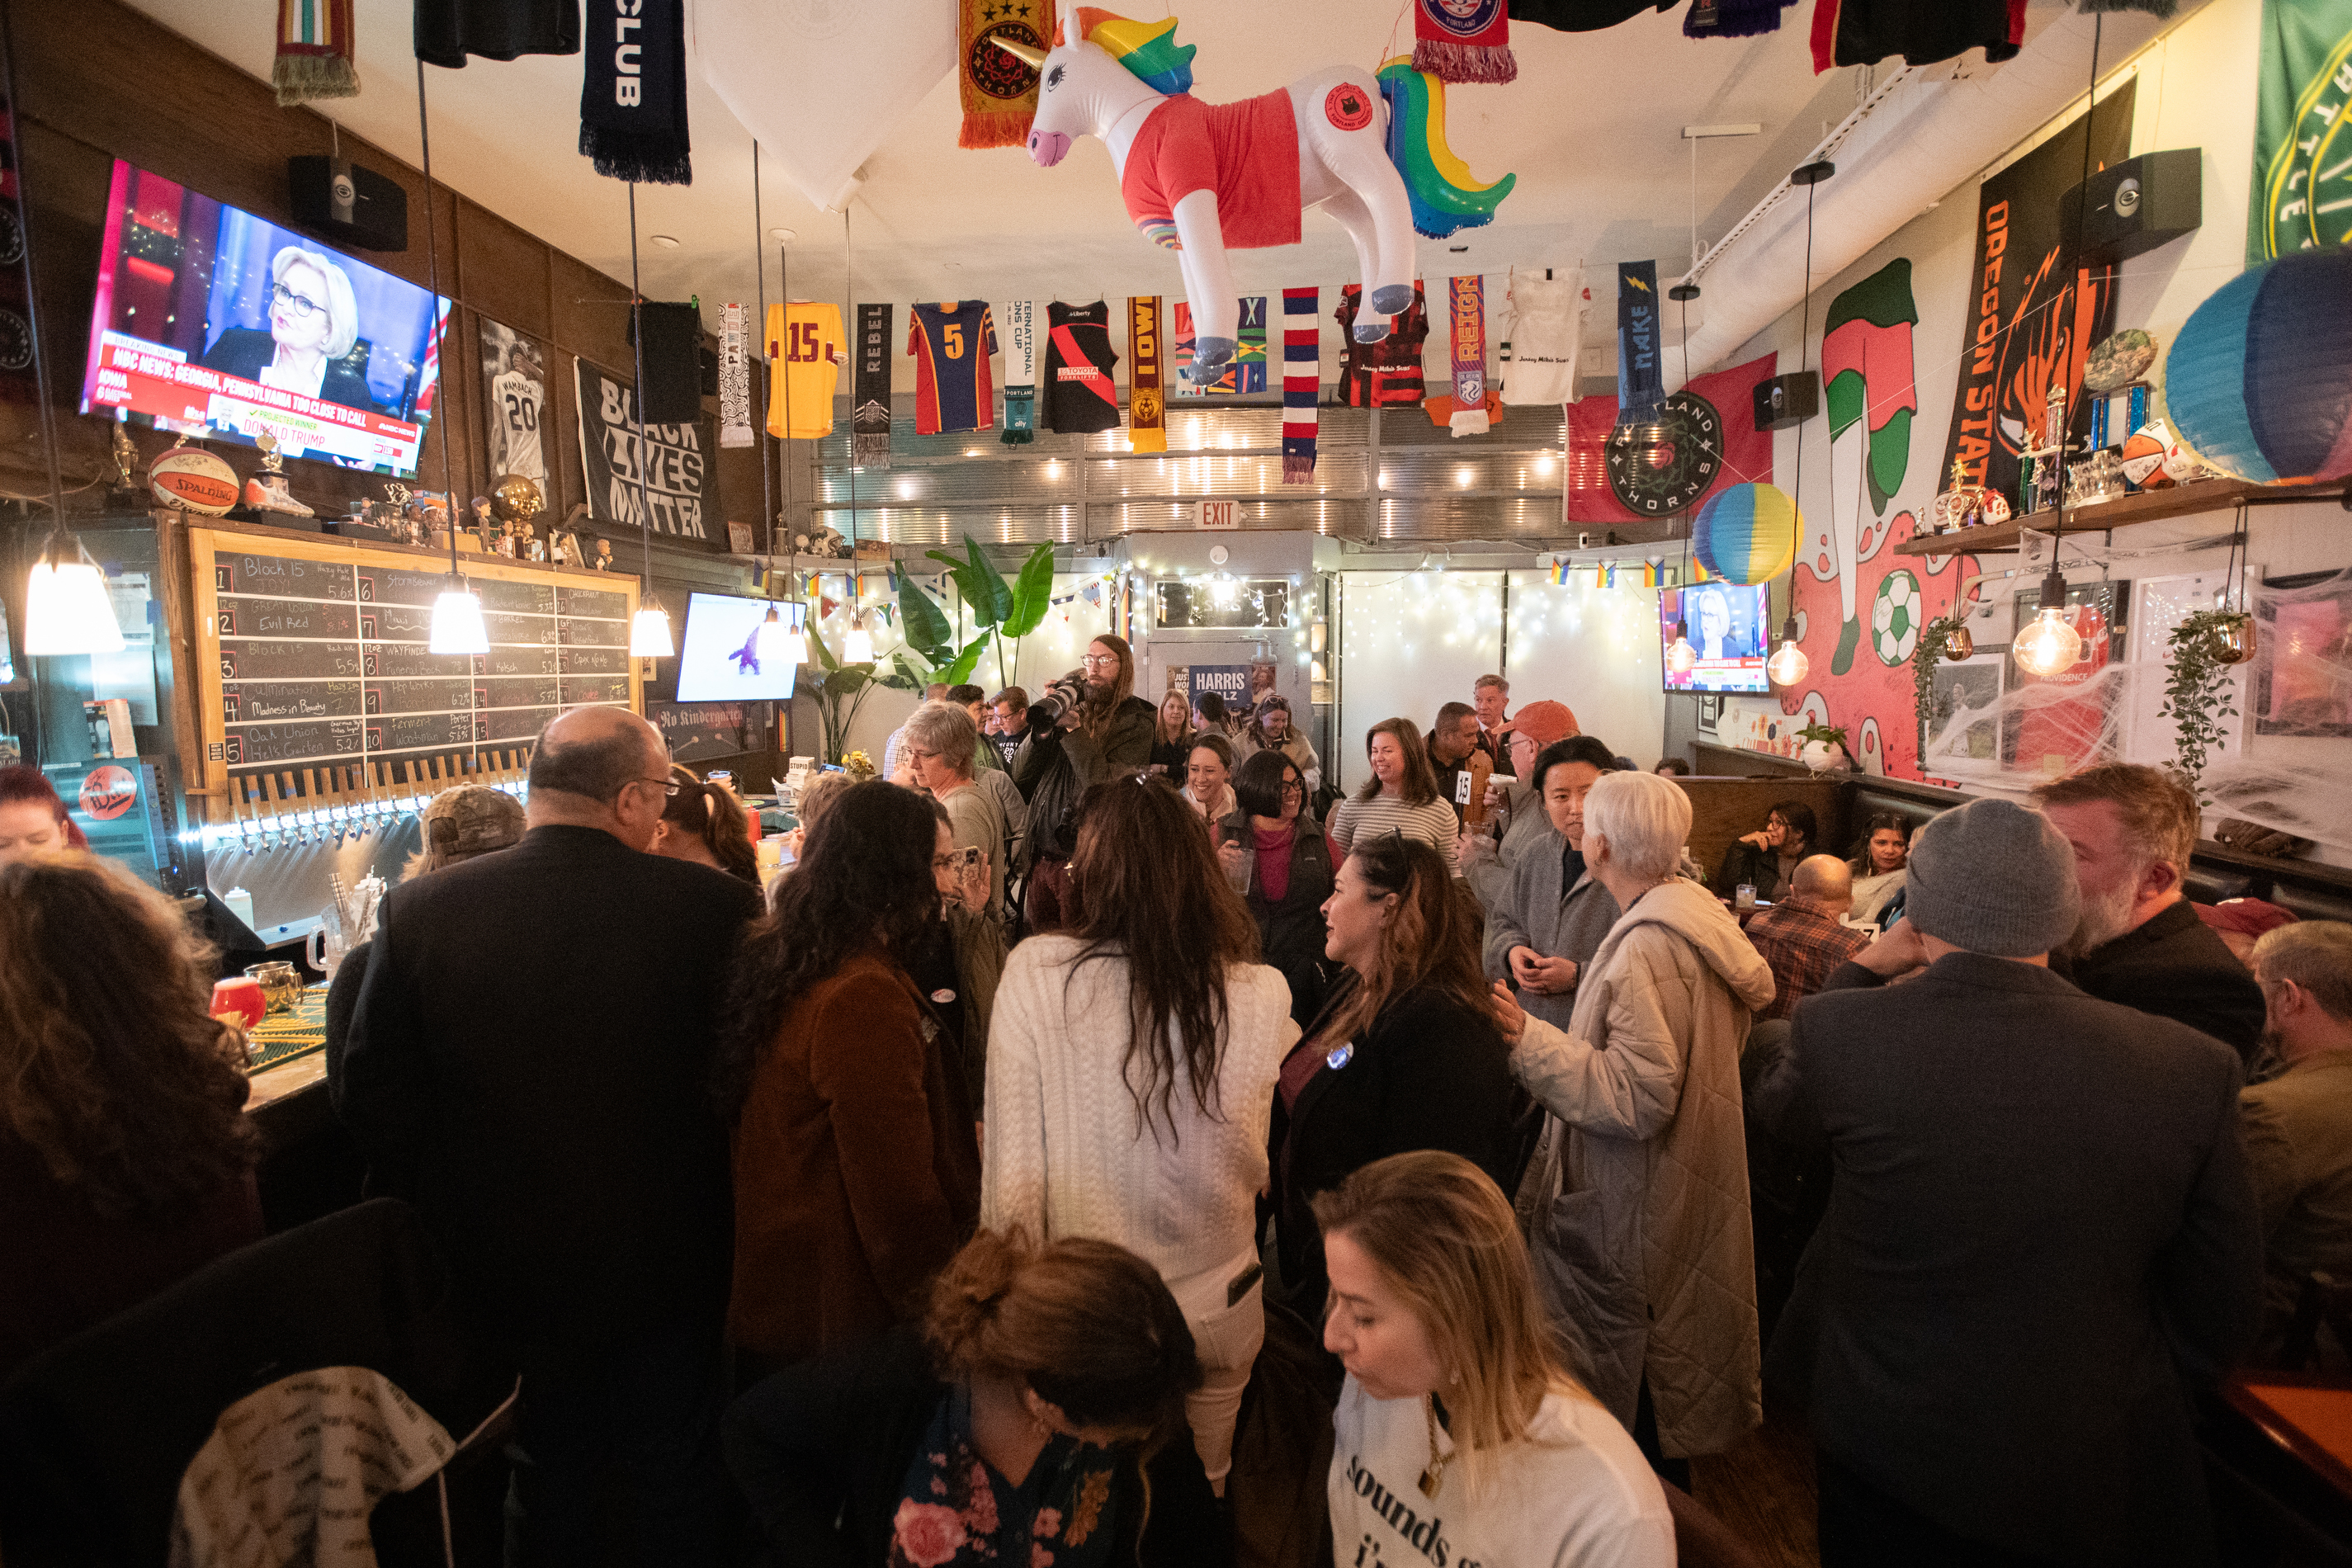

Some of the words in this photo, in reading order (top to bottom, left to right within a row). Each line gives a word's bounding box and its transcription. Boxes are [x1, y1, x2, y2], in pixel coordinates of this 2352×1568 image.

[1446, 17, 1476, 28] PORTLAND
[976, 27, 1037, 54] PORTLAND
[616, 0, 642, 106] CLUB
[1972, 200, 2009, 375] OREGON
[1457, 276, 1479, 361] REIGN
[787, 323, 819, 362] 15
[867, 307, 882, 372] REBEL
[943, 324, 964, 359] 5
[1631, 305, 1654, 371] MAKE
[115, 336, 155, 352] BREAKING
[158, 348, 179, 360] NEWS
[1361, 364, 1378, 372] Jersey
[99, 369, 127, 388] IOWA
[97, 386, 105, 399] 6
[113, 348, 139, 370] NBC
[139, 356, 174, 379] NEWS:
[174, 365, 222, 393] GEORGIA,
[223, 377, 292, 409] PENNSYLVANIA
[293, 396, 309, 414] TOO
[309, 399, 336, 420] CLOSE
[337, 406, 347, 422] TO
[347, 409, 366, 427] CALL
[503, 380, 532, 395] WAMBACH
[260, 410, 294, 426] PROJECTED
[295, 418, 317, 430] WINNER
[506, 394, 536, 431] 20
[385, 424, 399, 434] NBC
[399, 428, 415, 437] NEWS
[1014, 419, 1027, 428] ally
[291, 430, 325, 447] TRUMP
[607, 427, 703, 494] LIVES
[176, 479, 233, 501] SPALDING
[1618, 462, 1711, 509] THORNS
[610, 476, 706, 538] MATTER
[1203, 503, 1233, 525] EXIT
[245, 558, 286, 577] Block
[291, 562, 305, 577] 15
[218, 571, 224, 588] 1
[328, 586, 352, 599] 5.6%
[361, 583, 371, 600] 6
[557, 601, 565, 612] 16
[220, 616, 233, 632] 2
[260, 616, 281, 631] Evil
[287, 616, 309, 628] Red
[364, 621, 372, 637] 7
[290, 645, 304, 654] 15
[221, 660, 234, 678] 3
[366, 657, 375, 675] 8
[473, 662, 484, 674] 13
[1196, 673, 1245, 690] HARRIS
[2041, 673, 2088, 682] PROVIDENCE
[243, 682, 319, 701] Culmination
[451, 693, 470, 706] 6.2%
[252, 701, 286, 716] Madness
[289, 705, 297, 714] in
[300, 699, 326, 716] Beauty
[367, 695, 375, 713] 9
[475, 696, 485, 707] 14
[225, 701, 237, 722] 4
[450, 714, 470, 725] Porter
[250, 728, 276, 742] Oak
[285, 726, 319, 739] Union
[449, 730, 468, 743] 5.6%
[475, 726, 487, 739] 15
[337, 739, 358, 751] 5.2%
[367, 734, 380, 749] 10
[227, 744, 239, 762] 5
[1460, 777, 1469, 799] 15
[1347, 1455, 1451, 1568] sounds
